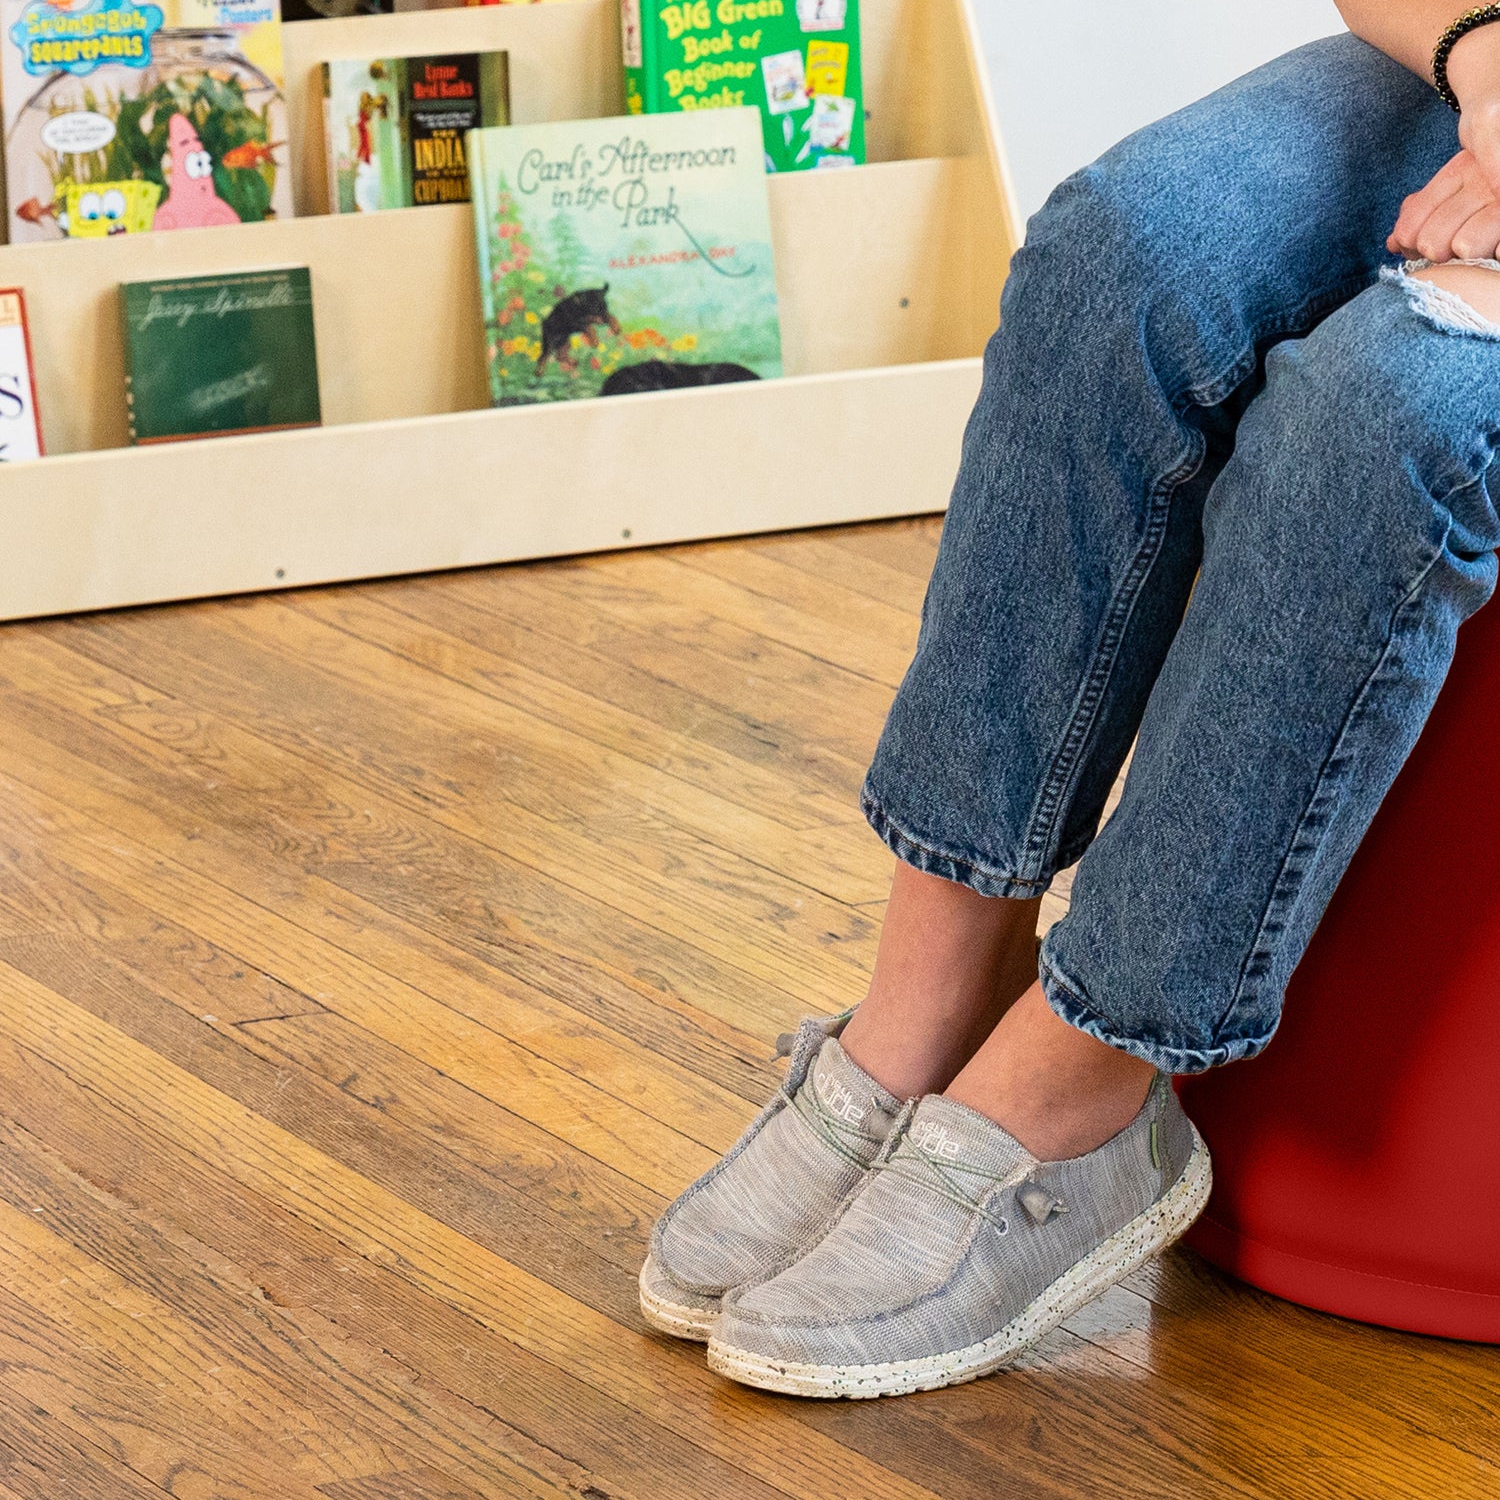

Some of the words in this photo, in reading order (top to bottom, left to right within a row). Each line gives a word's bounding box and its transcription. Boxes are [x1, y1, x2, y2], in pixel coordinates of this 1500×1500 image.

[681, 29, 734, 63] Book
[738, 29, 762, 49] of
[663, 60, 757, 97] Beginner
[677, 86, 745, 111] Books
[413, 137, 466, 170] INDIA
[517, 144, 593, 195] Carl's
[599, 136, 737, 177] Afternoon
[552, 185, 574, 209] in
[575, 178, 611, 212] the
[608, 250, 701, 269] ALEXANDRA
